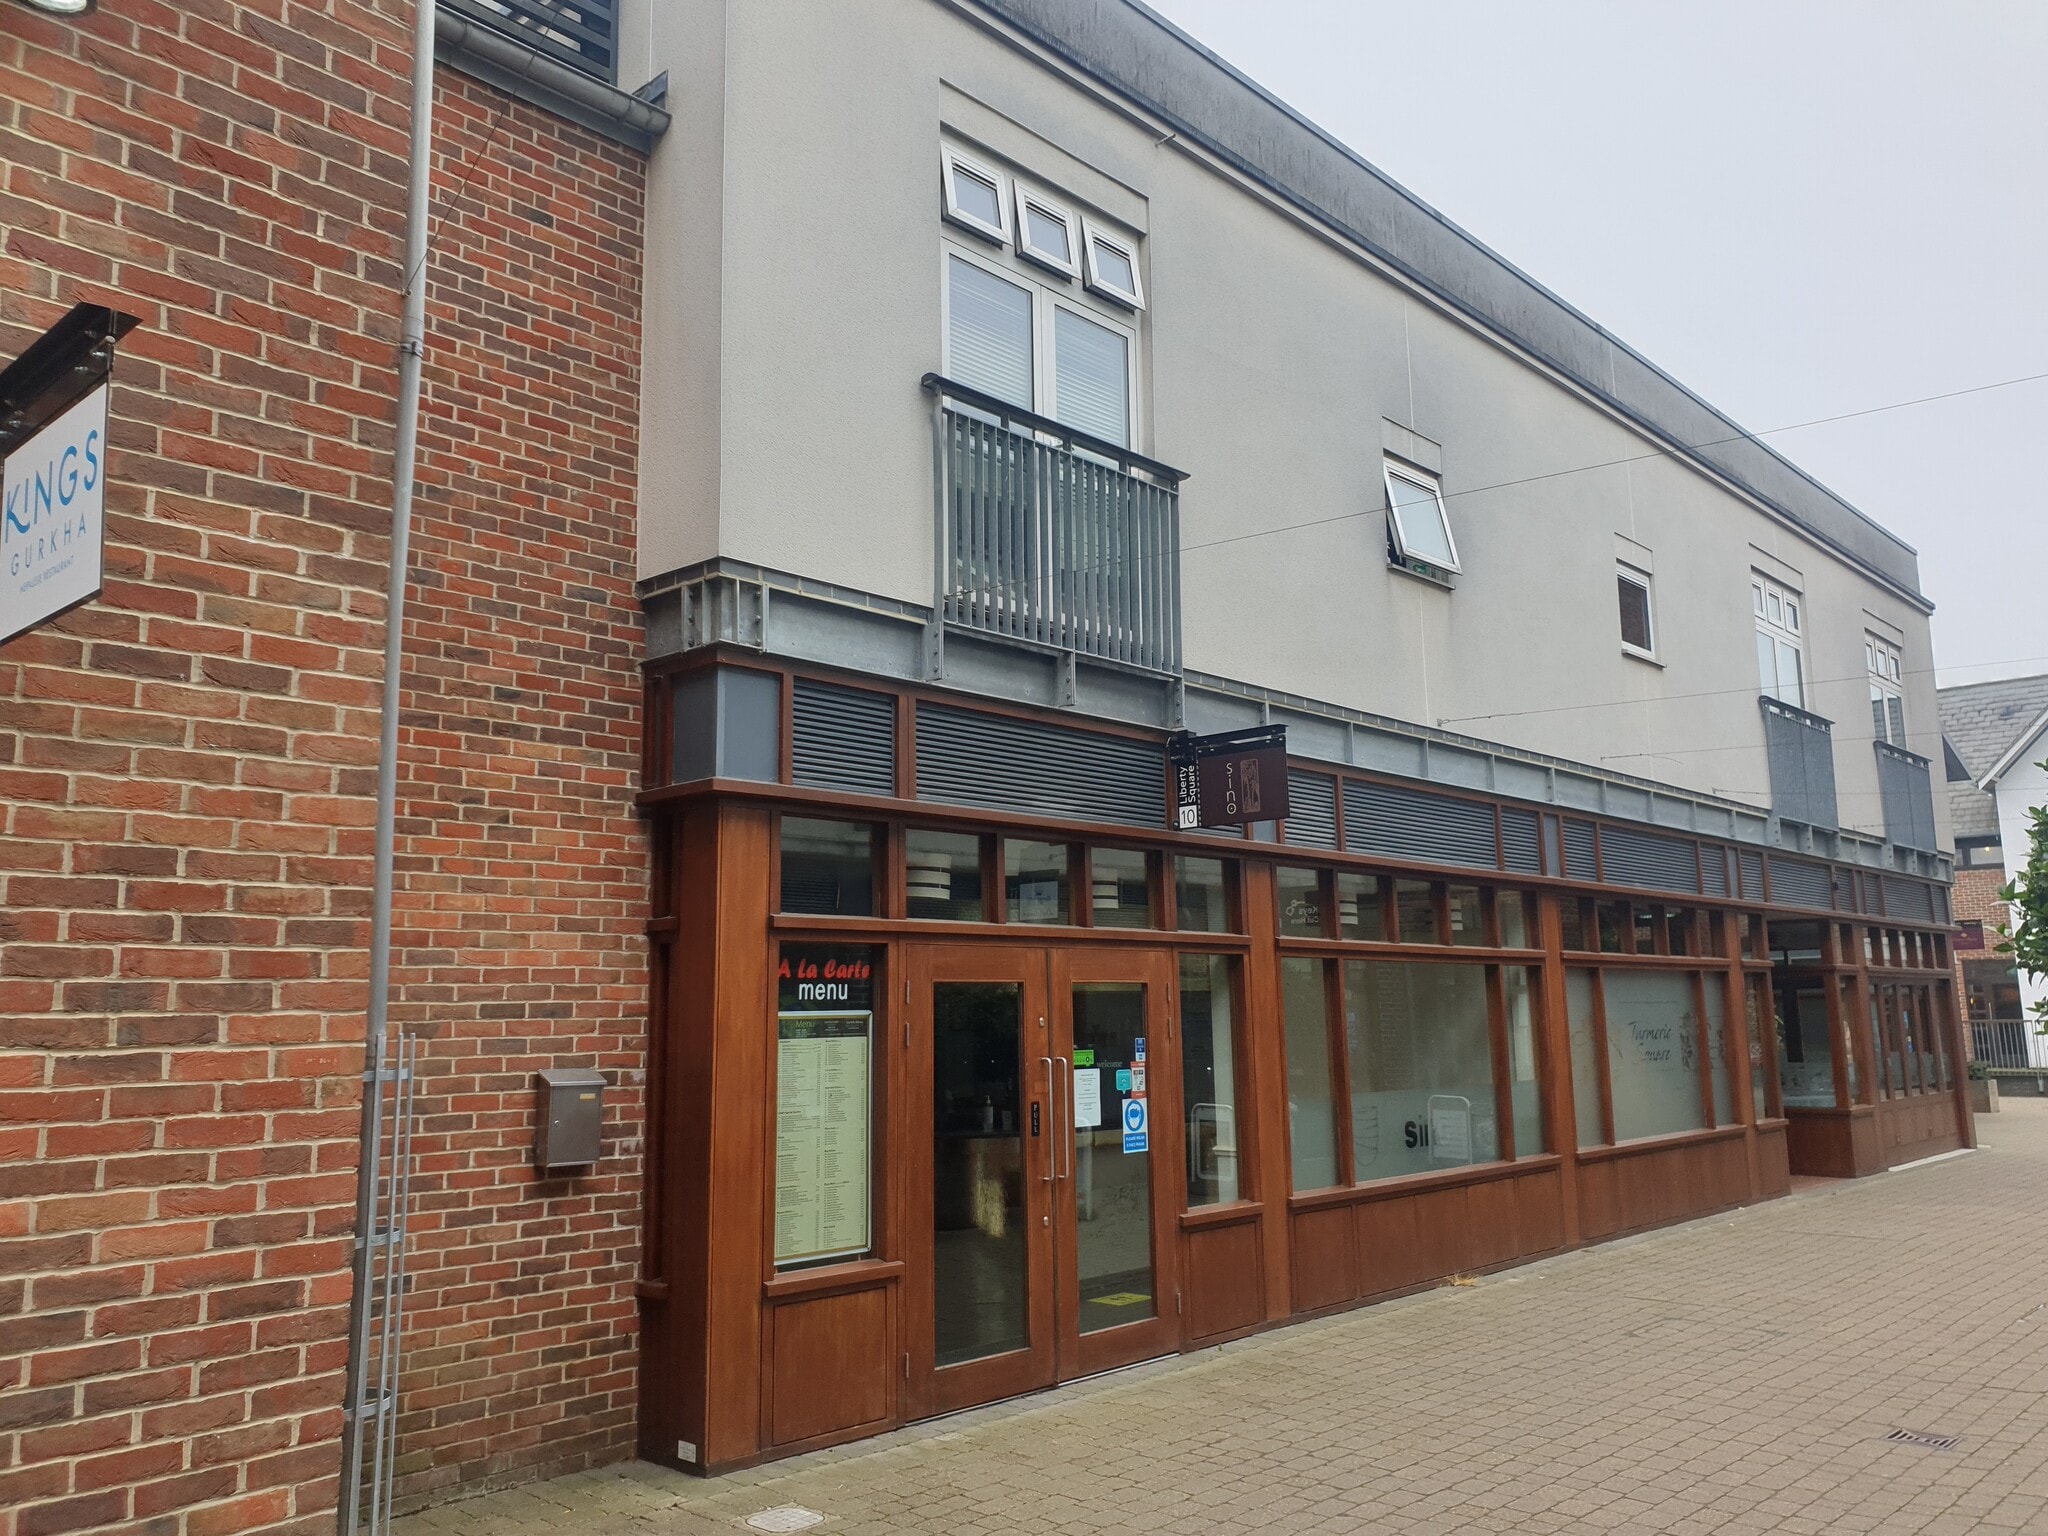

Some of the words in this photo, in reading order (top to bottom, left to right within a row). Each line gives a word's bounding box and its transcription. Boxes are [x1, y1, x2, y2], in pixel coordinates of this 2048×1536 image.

[4, 429, 98, 544] KINGS
[10, 512, 87, 577] GURKHA
[1179, 766, 1189, 804] Liberty
[1188, 765, 1196, 803] Square
[1181, 809, 1196, 825] 10
[778, 958, 791, 978] A
[797, 958, 818, 979] La
[824, 958, 871, 979] Carte
[798, 983, 848, 1001] menu
[794, 1020, 815, 1028] Menu
[1628, 1021, 1672, 1040] Turmeric
[1096, 1059, 1123, 1068] welcome
